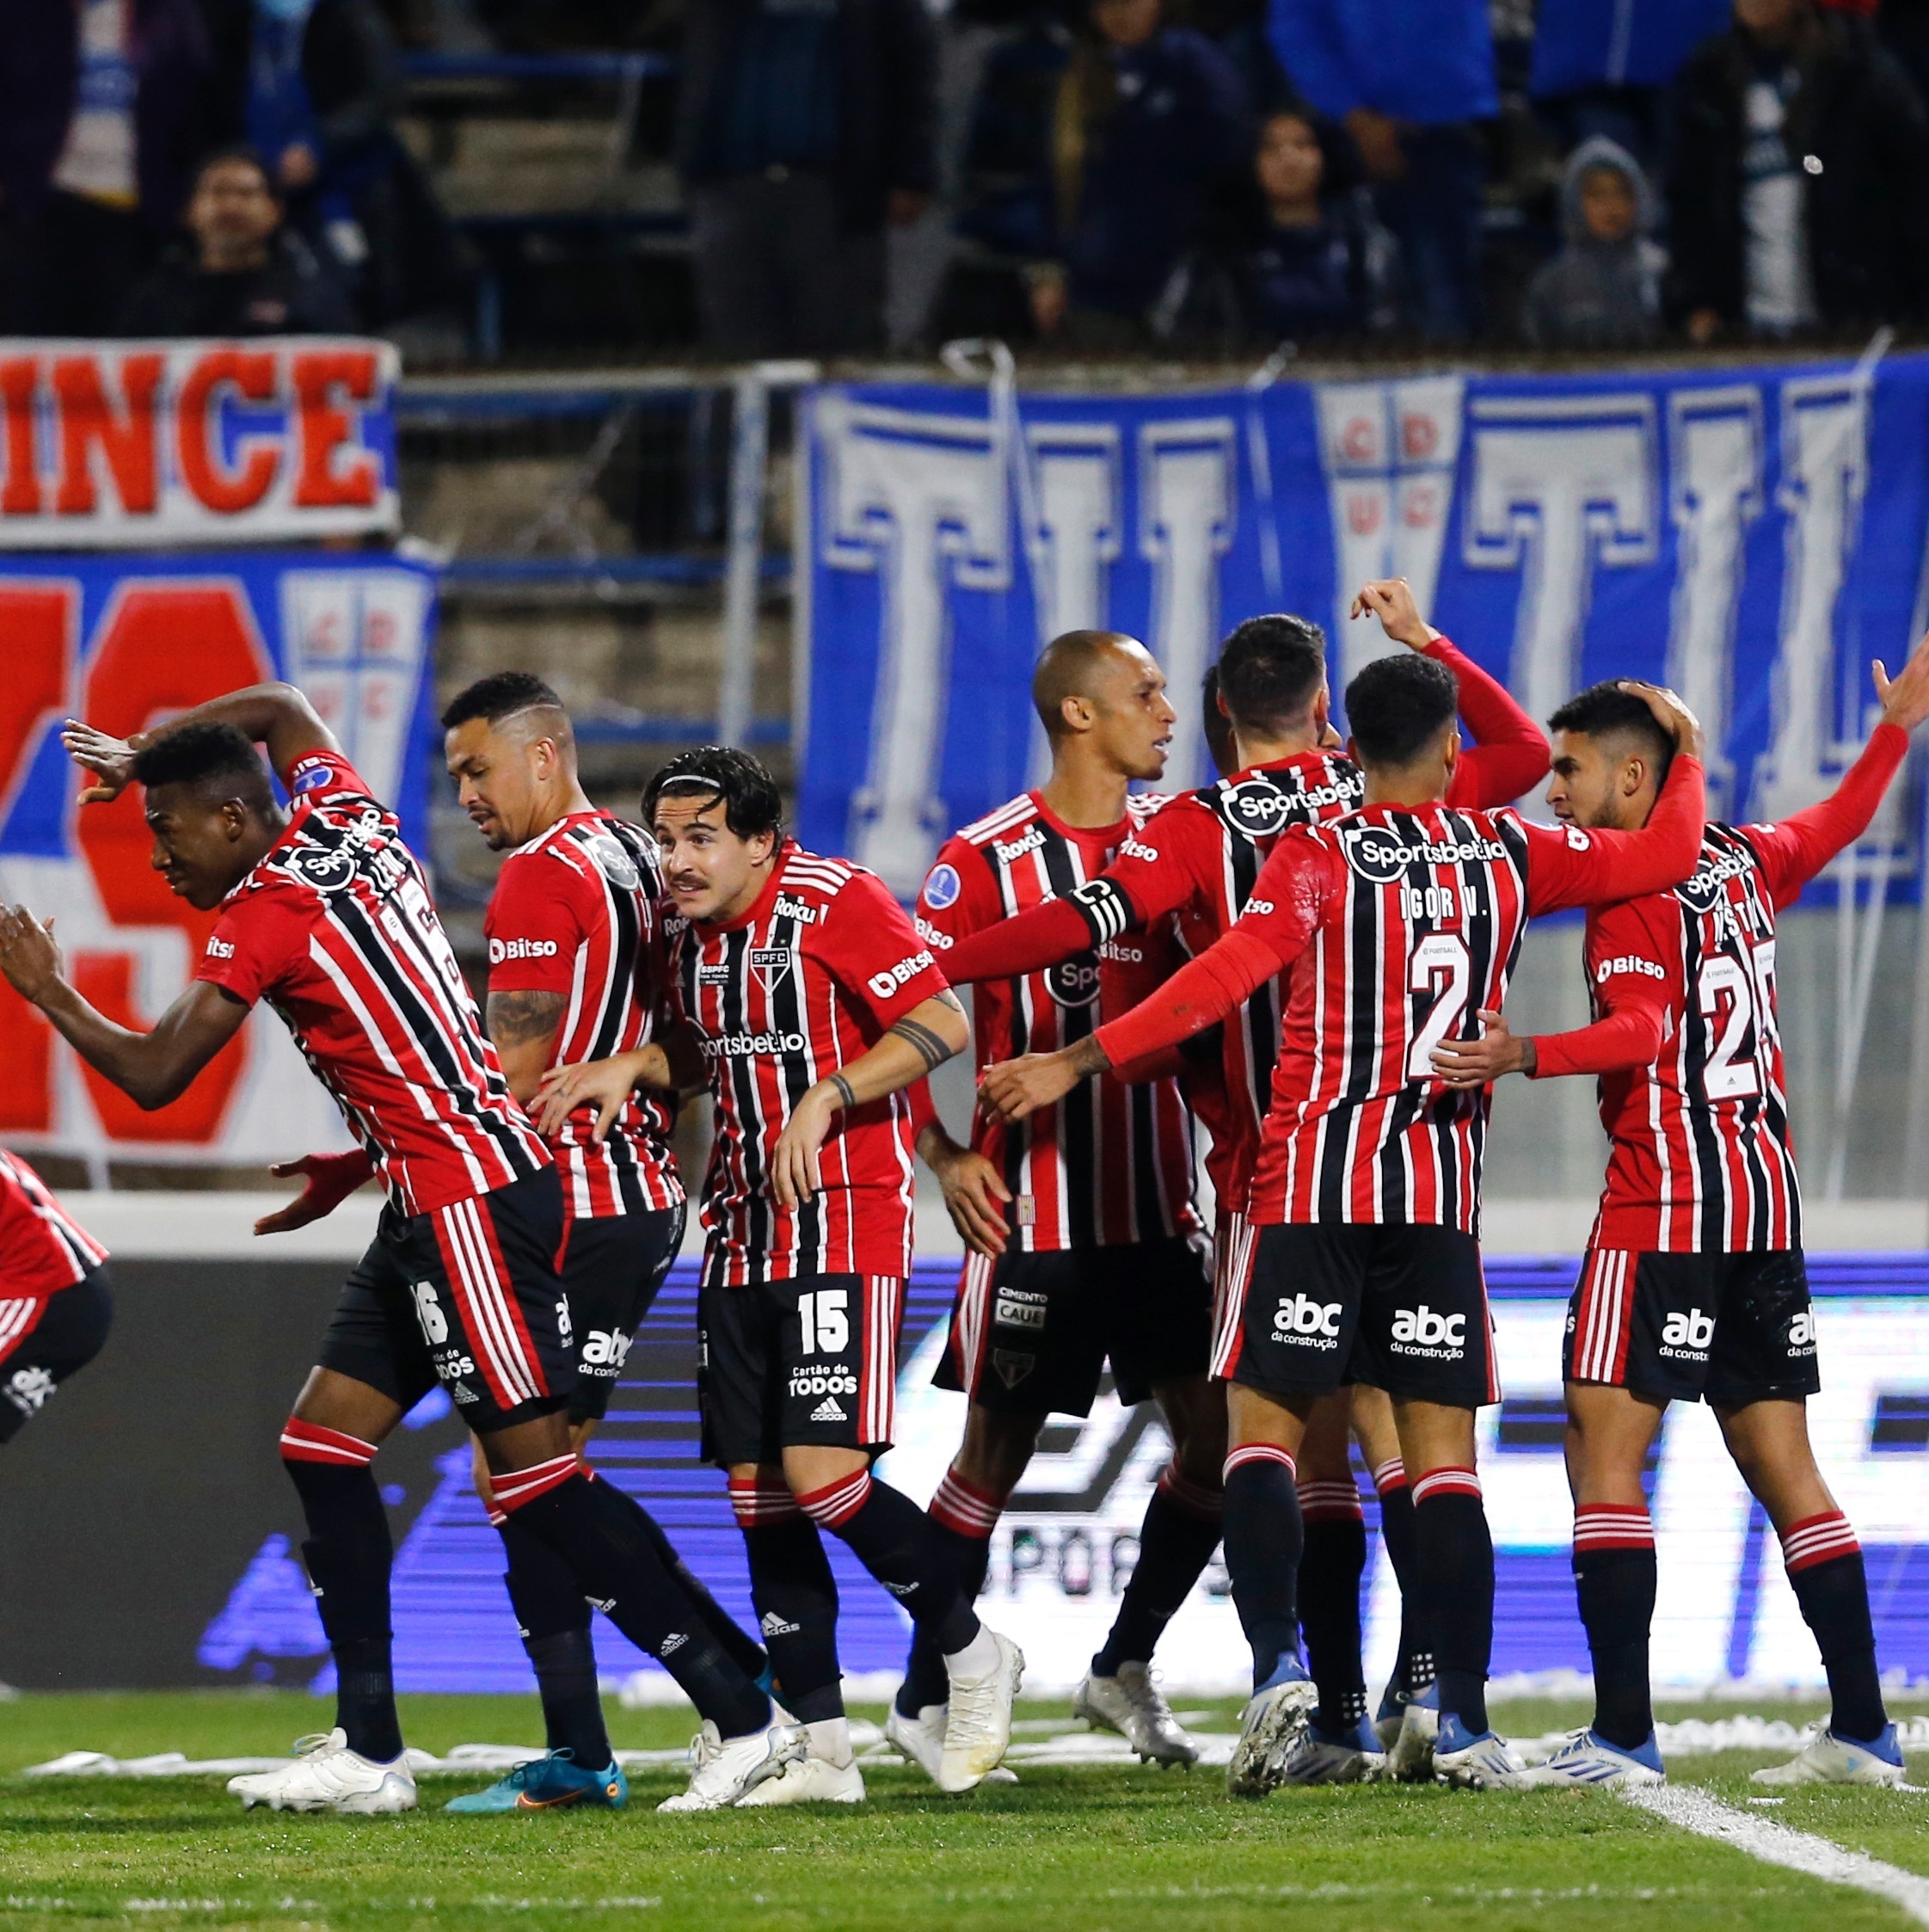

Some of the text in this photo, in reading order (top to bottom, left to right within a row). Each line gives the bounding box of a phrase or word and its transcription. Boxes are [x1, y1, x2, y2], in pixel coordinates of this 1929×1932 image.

[995, 829, 1047, 864] Roku
[1362, 839, 1506, 869] Sportsbet.io
[773, 895, 816, 923] Roku
[1399, 885, 1487, 920] IGOR V.
[506, 938, 557, 958] Bitso
[753, 954, 787, 963] SPFC
[891, 949, 935, 985] Bitso
[1613, 956, 1666, 981] Bitso
[1408, 932, 1471, 1080] 2
[998, 1287, 1048, 1303] CIMENTO
[797, 1289, 850, 1355] 15
[1274, 1293, 1343, 1336] abc
[1391, 1305, 1466, 1347] abc
[1271, 1331, 1284, 1342] da
[1662, 1307, 1717, 1349] ab
[1391, 1342, 1465, 1361] da construção
[1659, 1344, 1674, 1357] da
[793, 1363, 850, 1377] Cartão de
[788, 1375, 858, 1397] TODOS
[809, 1412, 848, 1422] adidas
